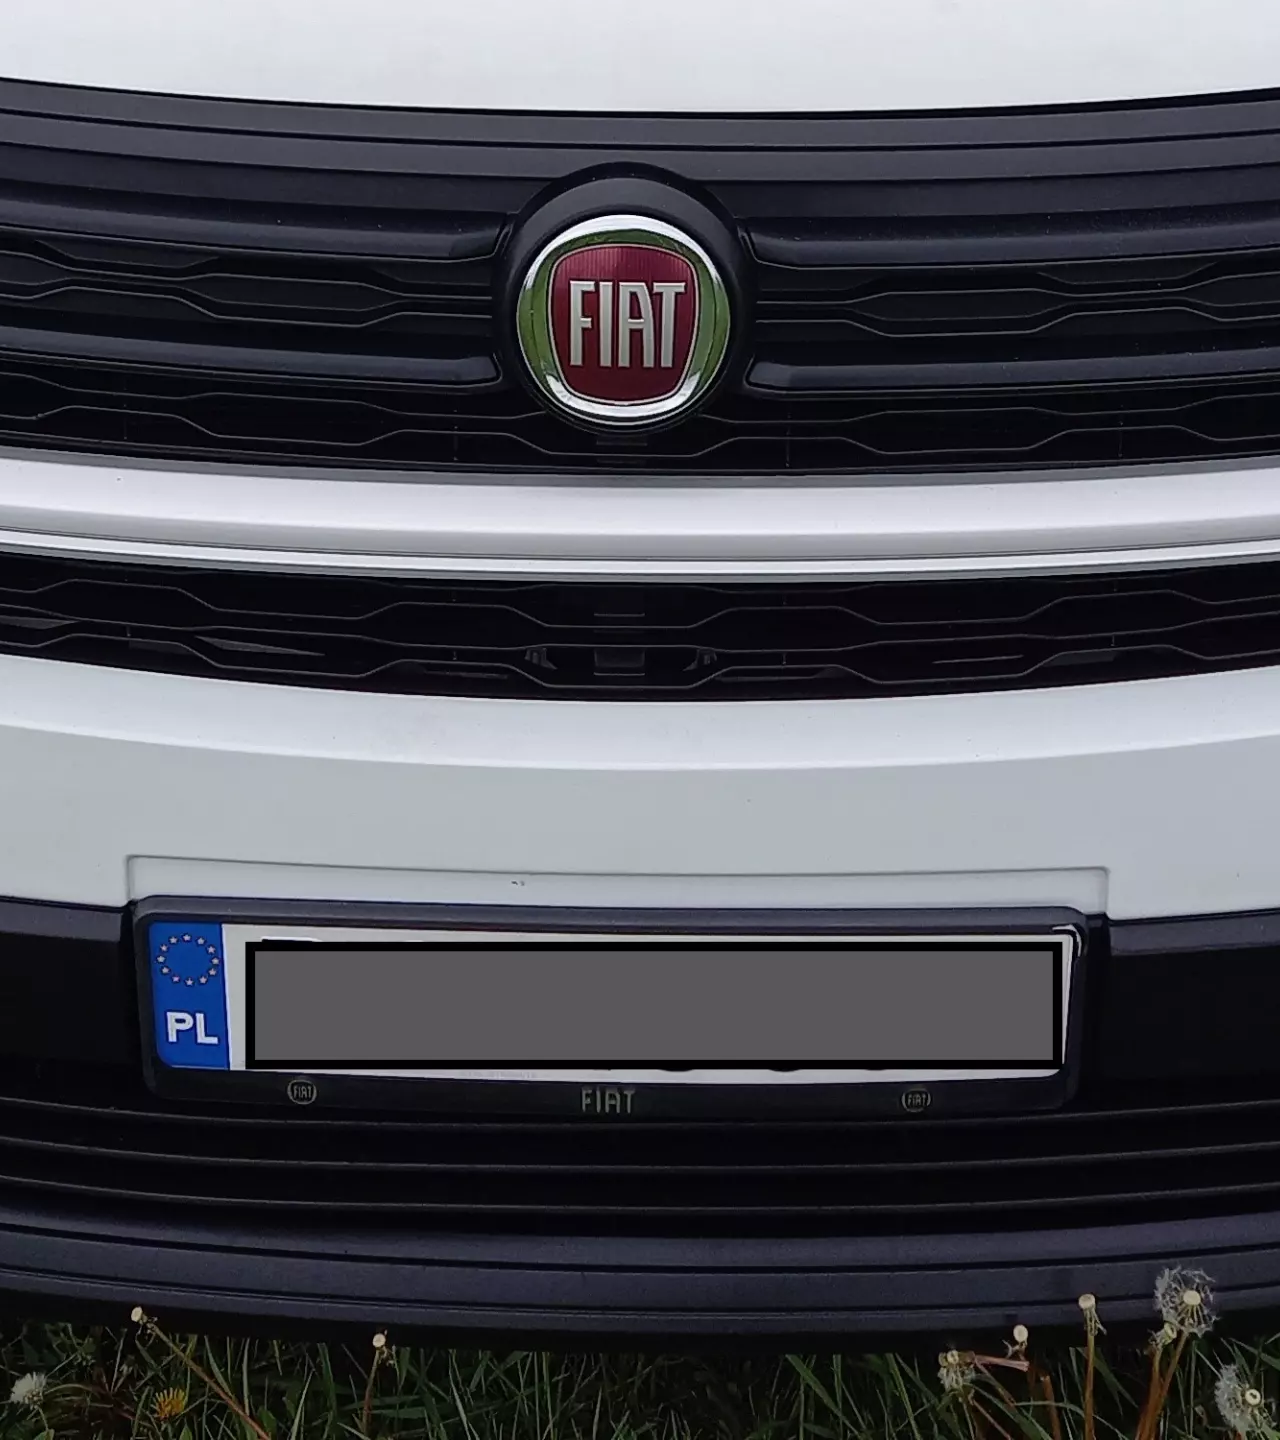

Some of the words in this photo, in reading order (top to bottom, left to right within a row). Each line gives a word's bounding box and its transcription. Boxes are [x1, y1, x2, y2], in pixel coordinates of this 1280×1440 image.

[569, 279, 687, 369] FIAT
[166, 1011, 219, 1045] PL
[293, 1084, 312, 1099] FIAT
[581, 1086, 636, 1114] FIAT
